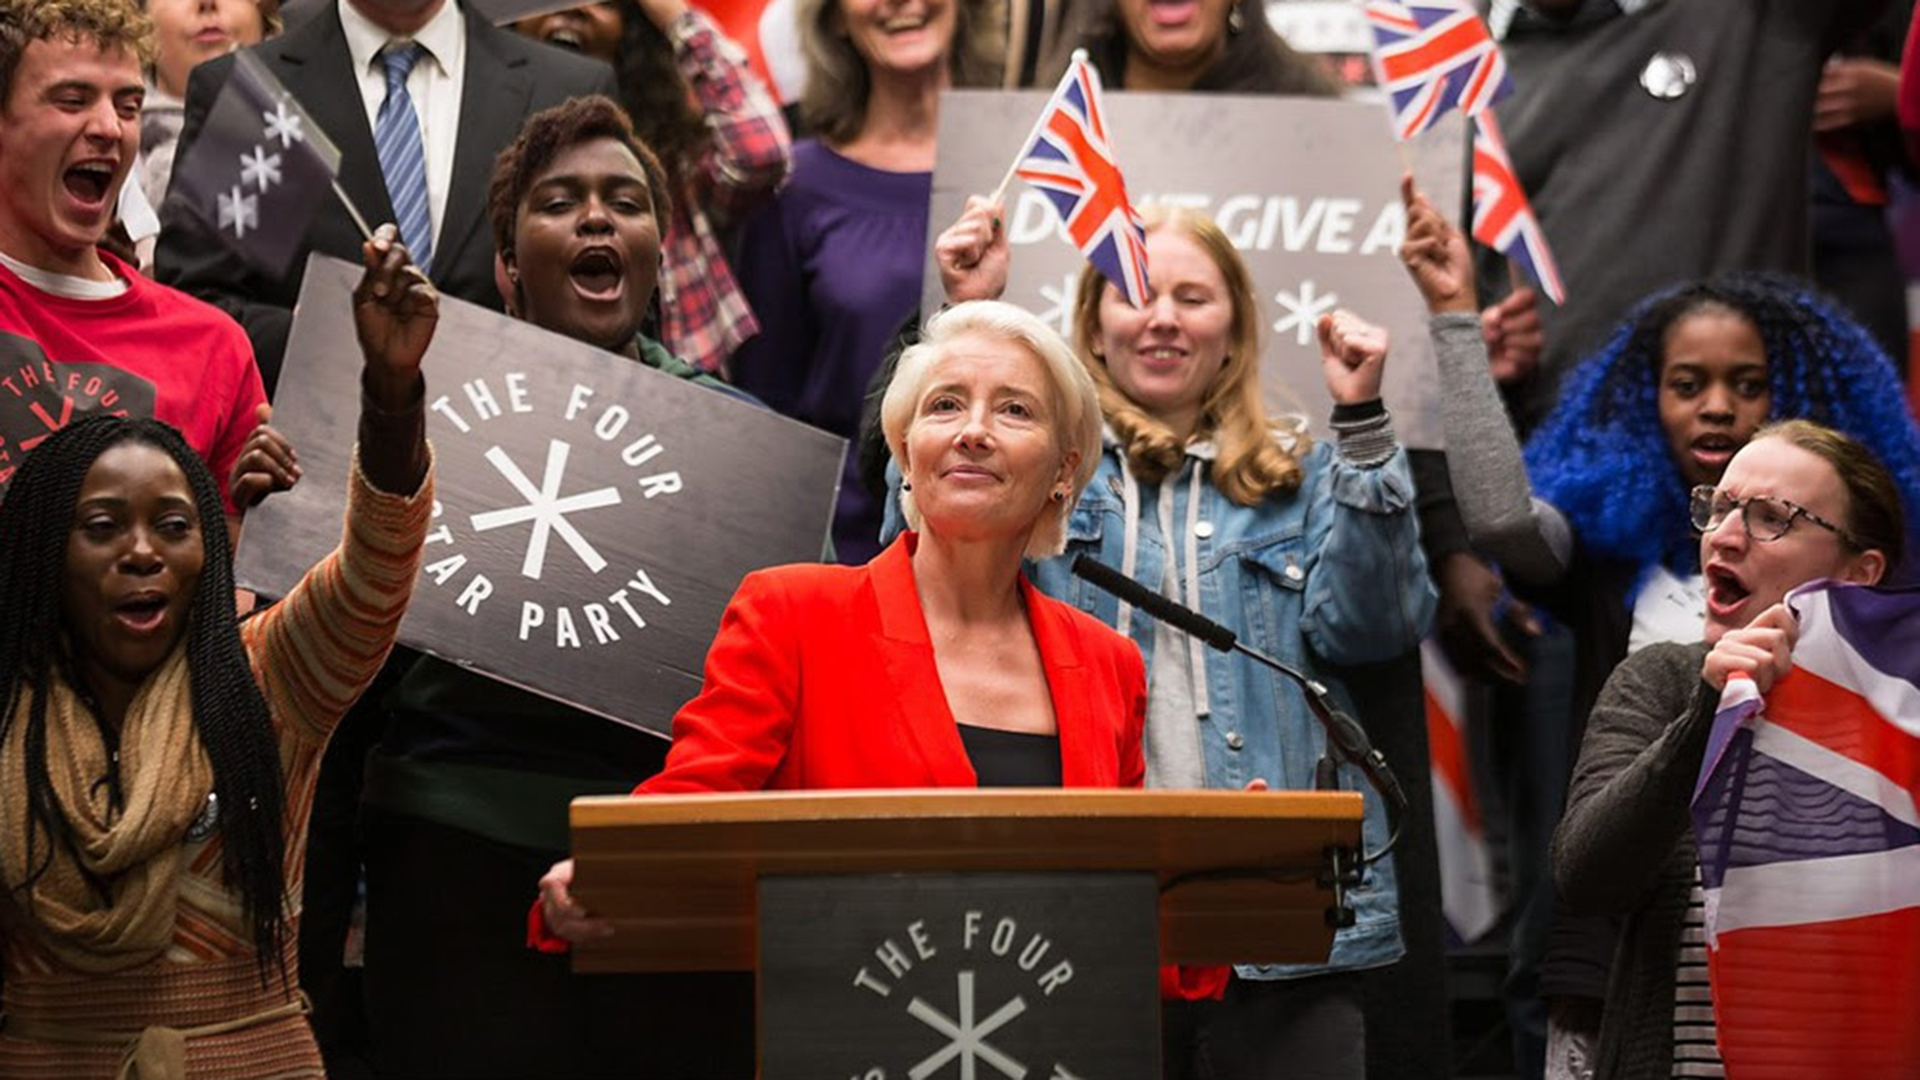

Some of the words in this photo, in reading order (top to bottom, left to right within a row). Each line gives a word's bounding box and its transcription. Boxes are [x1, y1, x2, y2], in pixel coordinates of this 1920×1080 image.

[1214, 193, 1363, 254] GIVE
[1360, 201, 1408, 256] A
[2, 361, 56, 397] THE
[431, 372, 533, 433] THE
[565, 383, 684, 499] FOUR
[519, 569, 672, 648] PARTY
[853, 919, 937, 997] THE
[963, 910, 1074, 996] FOUR
